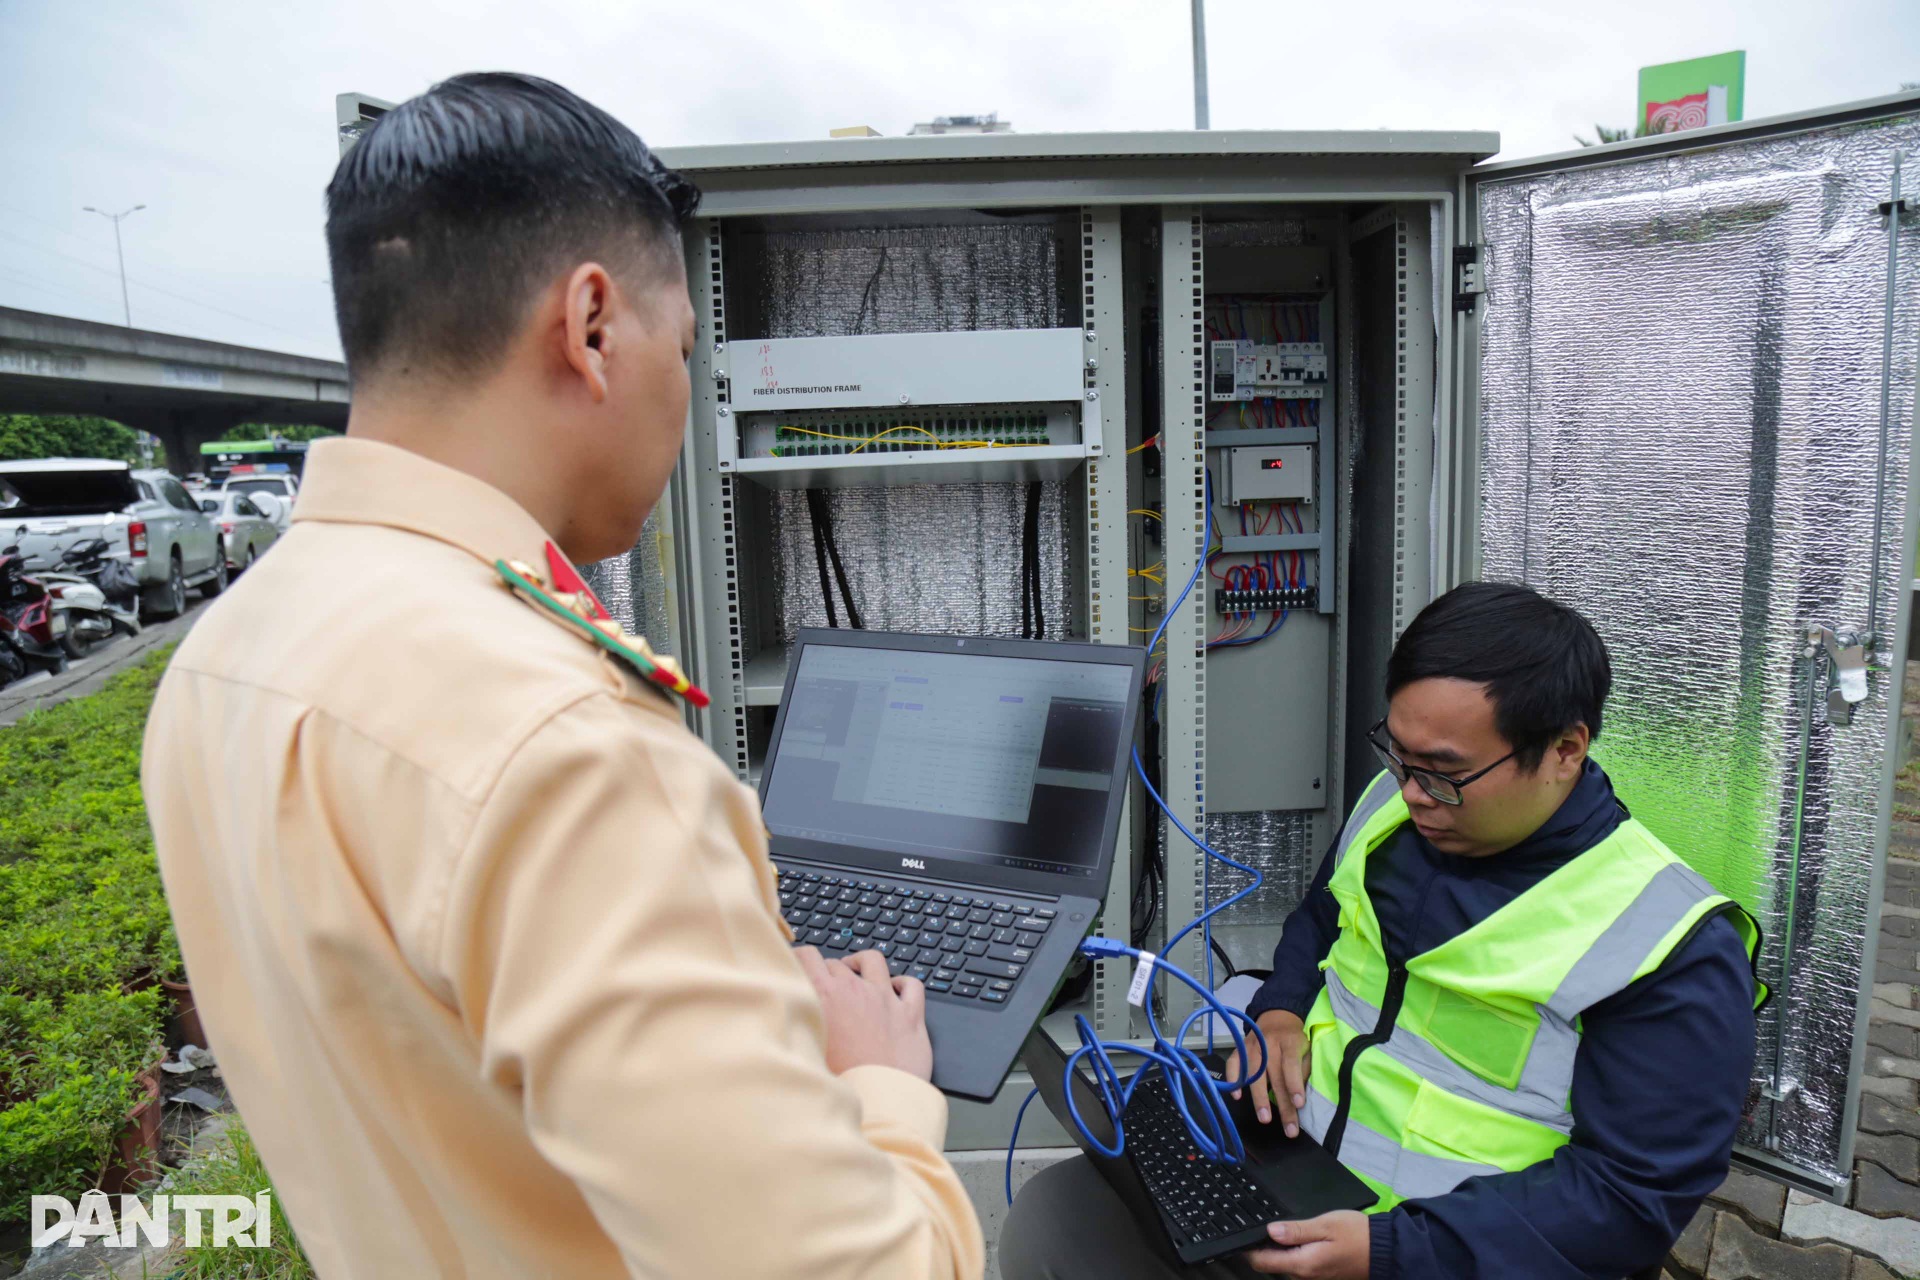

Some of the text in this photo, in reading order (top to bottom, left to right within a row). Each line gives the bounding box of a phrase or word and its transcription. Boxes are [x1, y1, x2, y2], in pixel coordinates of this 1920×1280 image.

[753, 384, 862, 396] FIBER DISTRIBUTION FRAME
[902, 858, 925, 870] DELL
